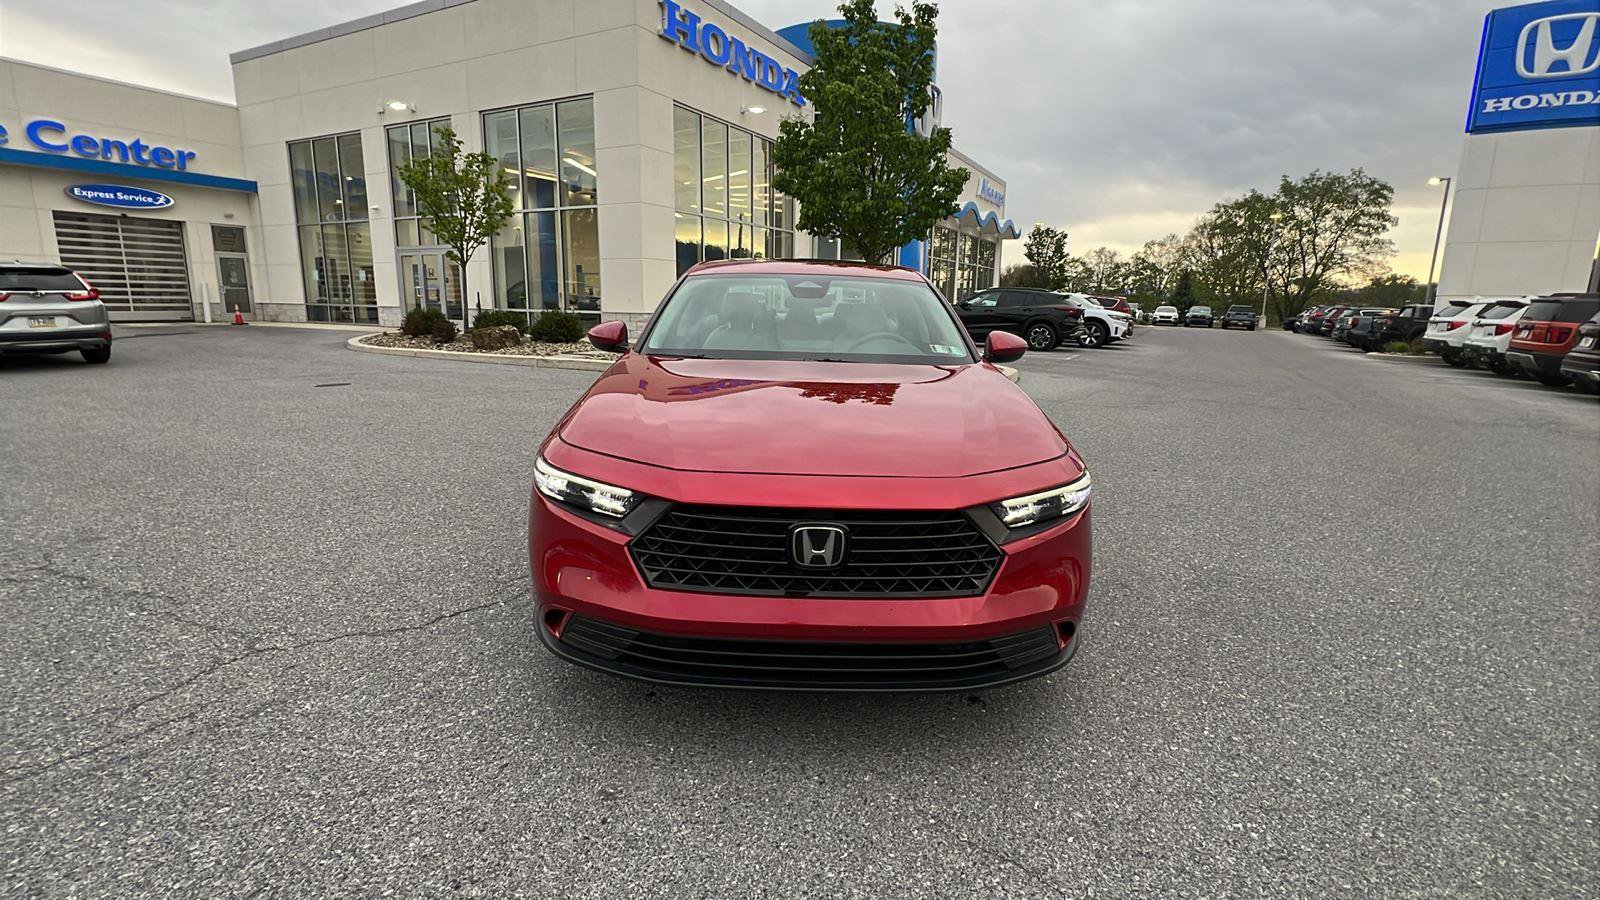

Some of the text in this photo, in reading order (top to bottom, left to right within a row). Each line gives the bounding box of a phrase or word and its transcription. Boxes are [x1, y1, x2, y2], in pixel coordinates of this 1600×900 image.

[660, 0, 806, 107] HONDA
[26, 120, 197, 171] Center
[73, 187, 153, 203] Express Service
